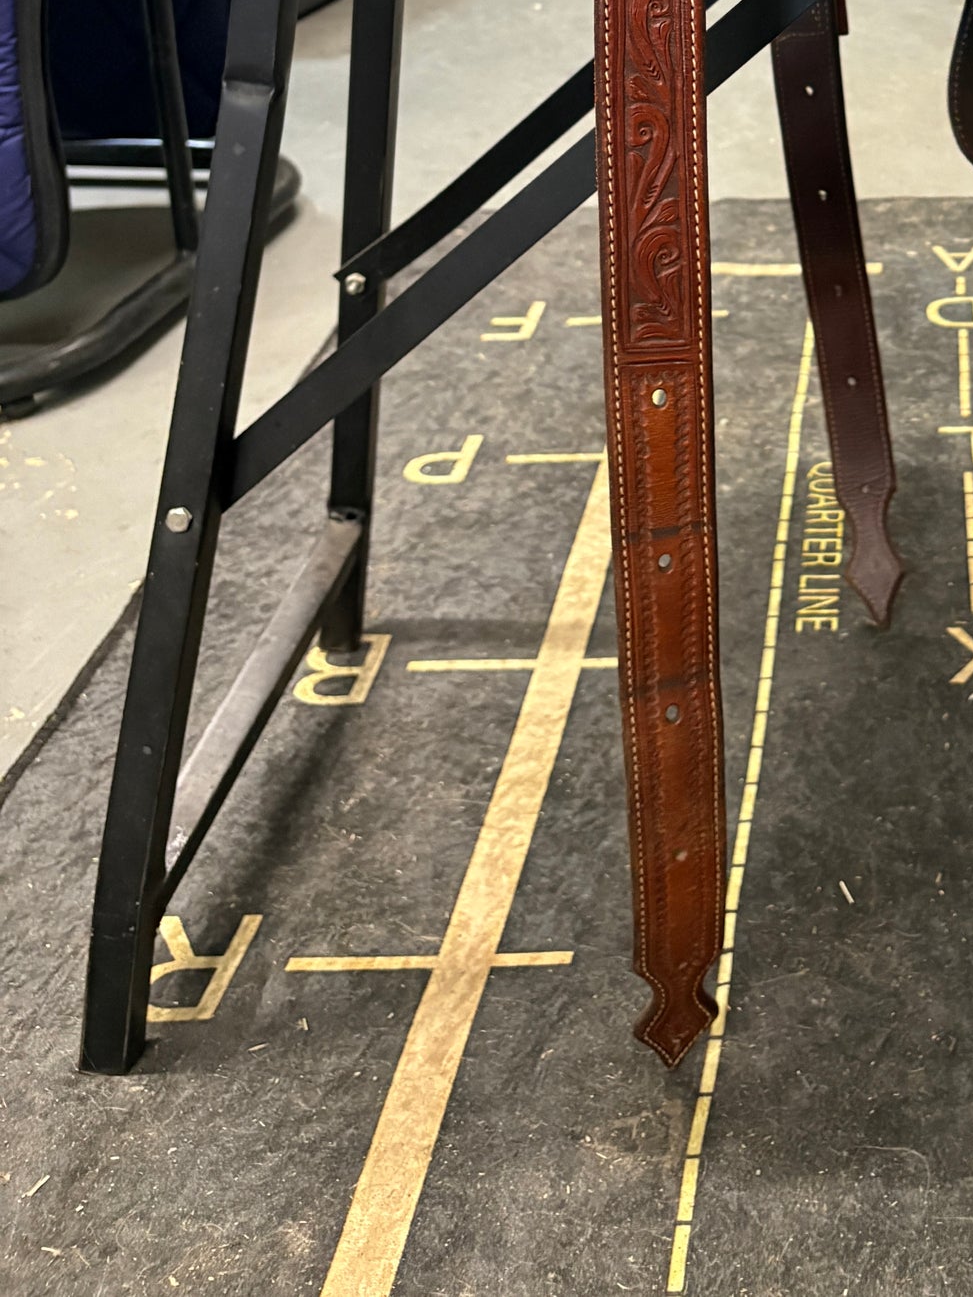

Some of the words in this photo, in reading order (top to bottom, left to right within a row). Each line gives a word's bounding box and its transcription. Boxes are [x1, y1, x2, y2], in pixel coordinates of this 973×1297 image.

[480, 301, 546, 342] F
[403, 434, 484, 485] P
[801, 461, 846, 568] QUARTER
[795, 574, 841, 633] LINE
[146, 914, 264, 1022] R
